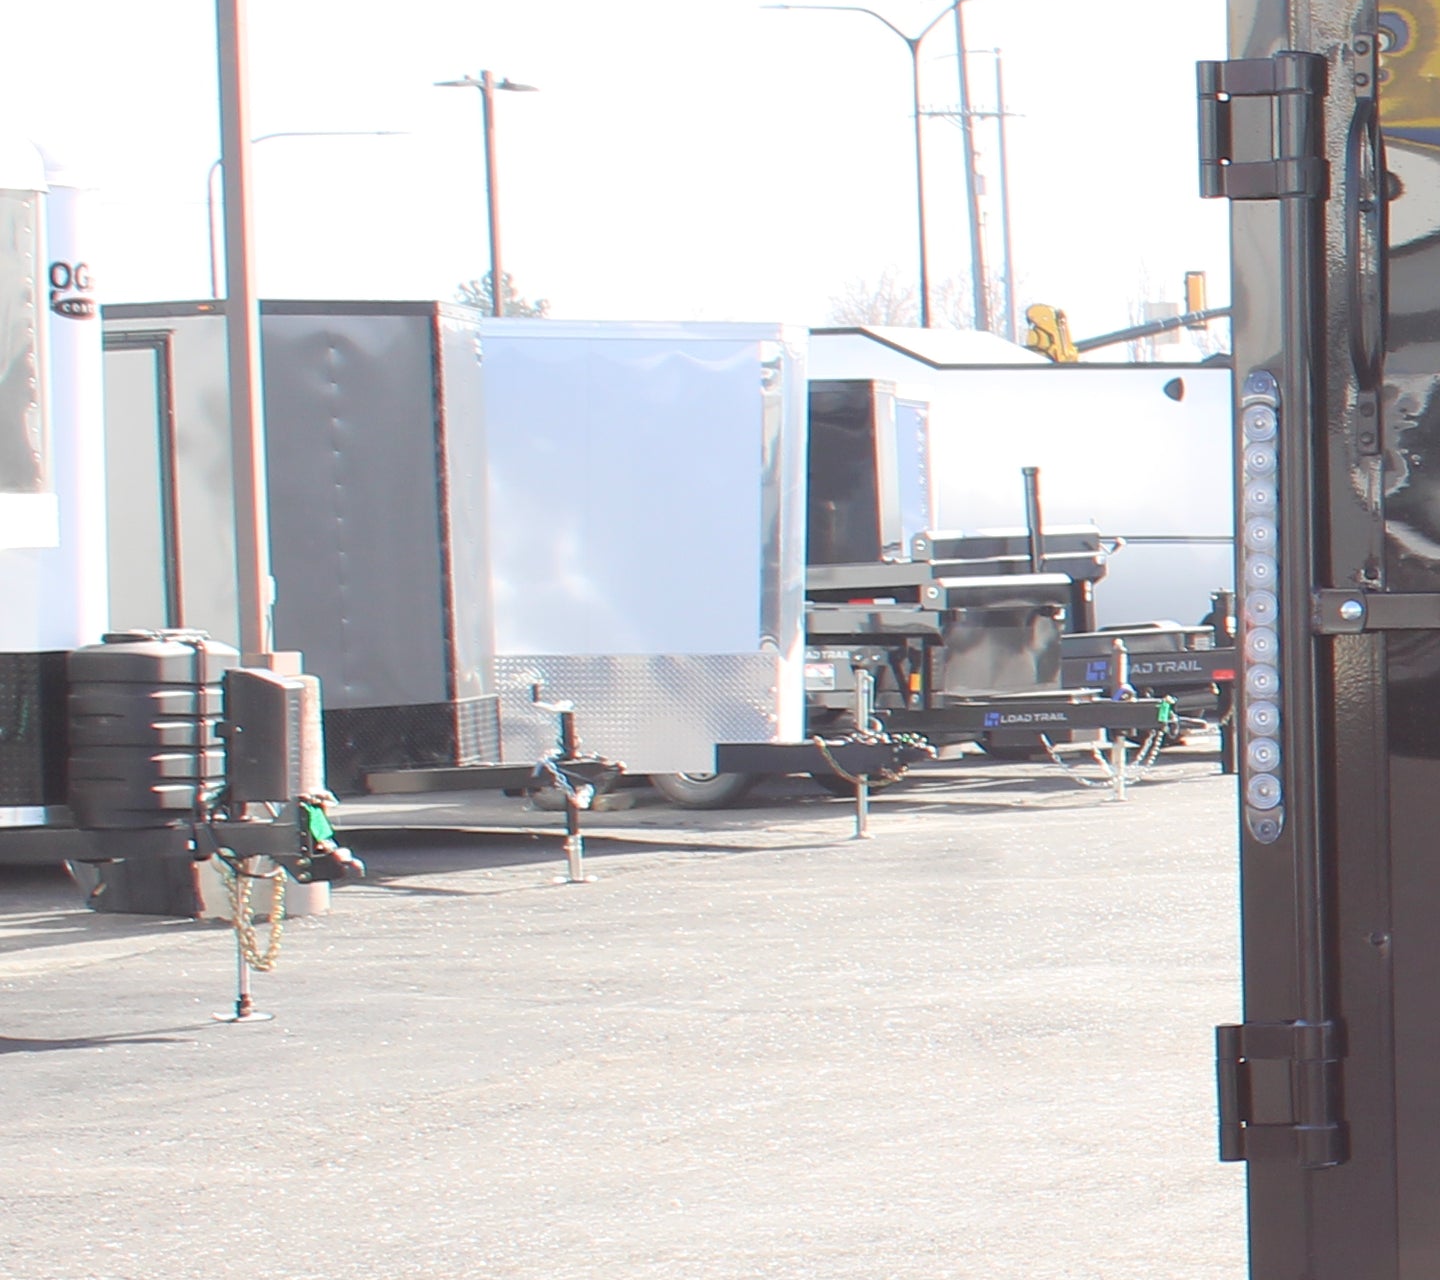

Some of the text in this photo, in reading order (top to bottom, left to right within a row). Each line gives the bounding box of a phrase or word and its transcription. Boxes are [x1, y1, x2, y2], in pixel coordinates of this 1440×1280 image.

[1156, 660, 1202, 673] TRAIL
[1000, 712, 1068, 724] LOAD TRAIL
